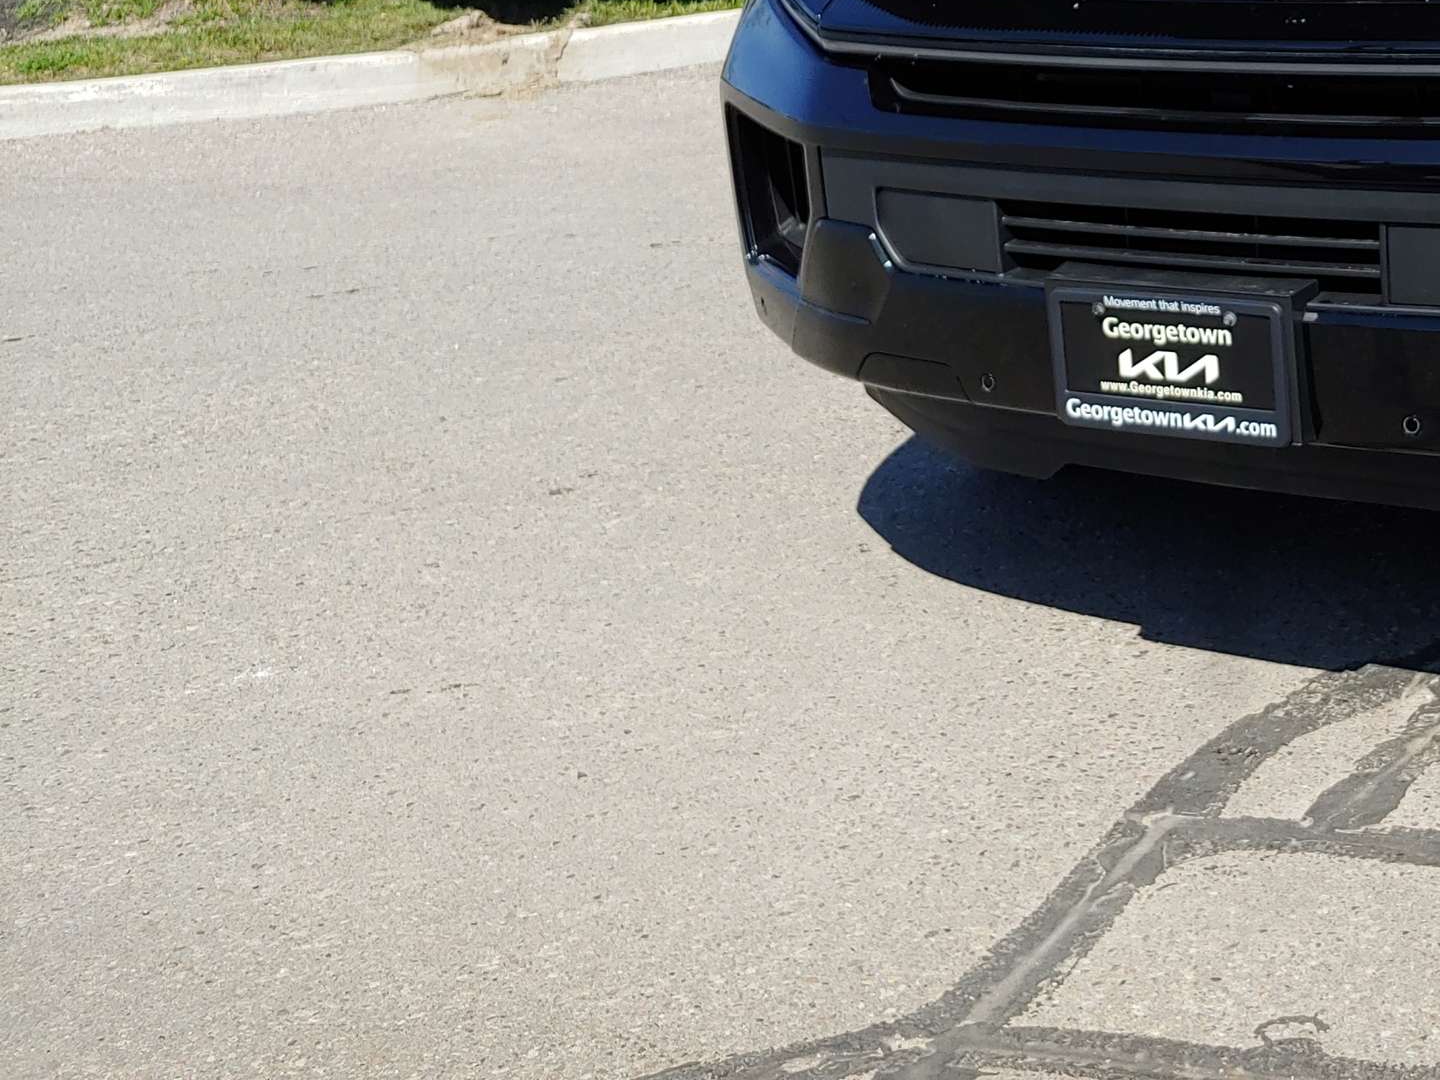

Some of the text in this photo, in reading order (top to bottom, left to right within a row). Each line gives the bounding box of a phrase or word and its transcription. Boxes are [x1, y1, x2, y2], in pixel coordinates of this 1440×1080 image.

[1103, 295, 1221, 315] Movement that inspires
[1102, 317, 1232, 346] Georgetown
[1118, 348, 1220, 385] KIA
[1100, 380, 1243, 403] www.Georgetownkia.com
